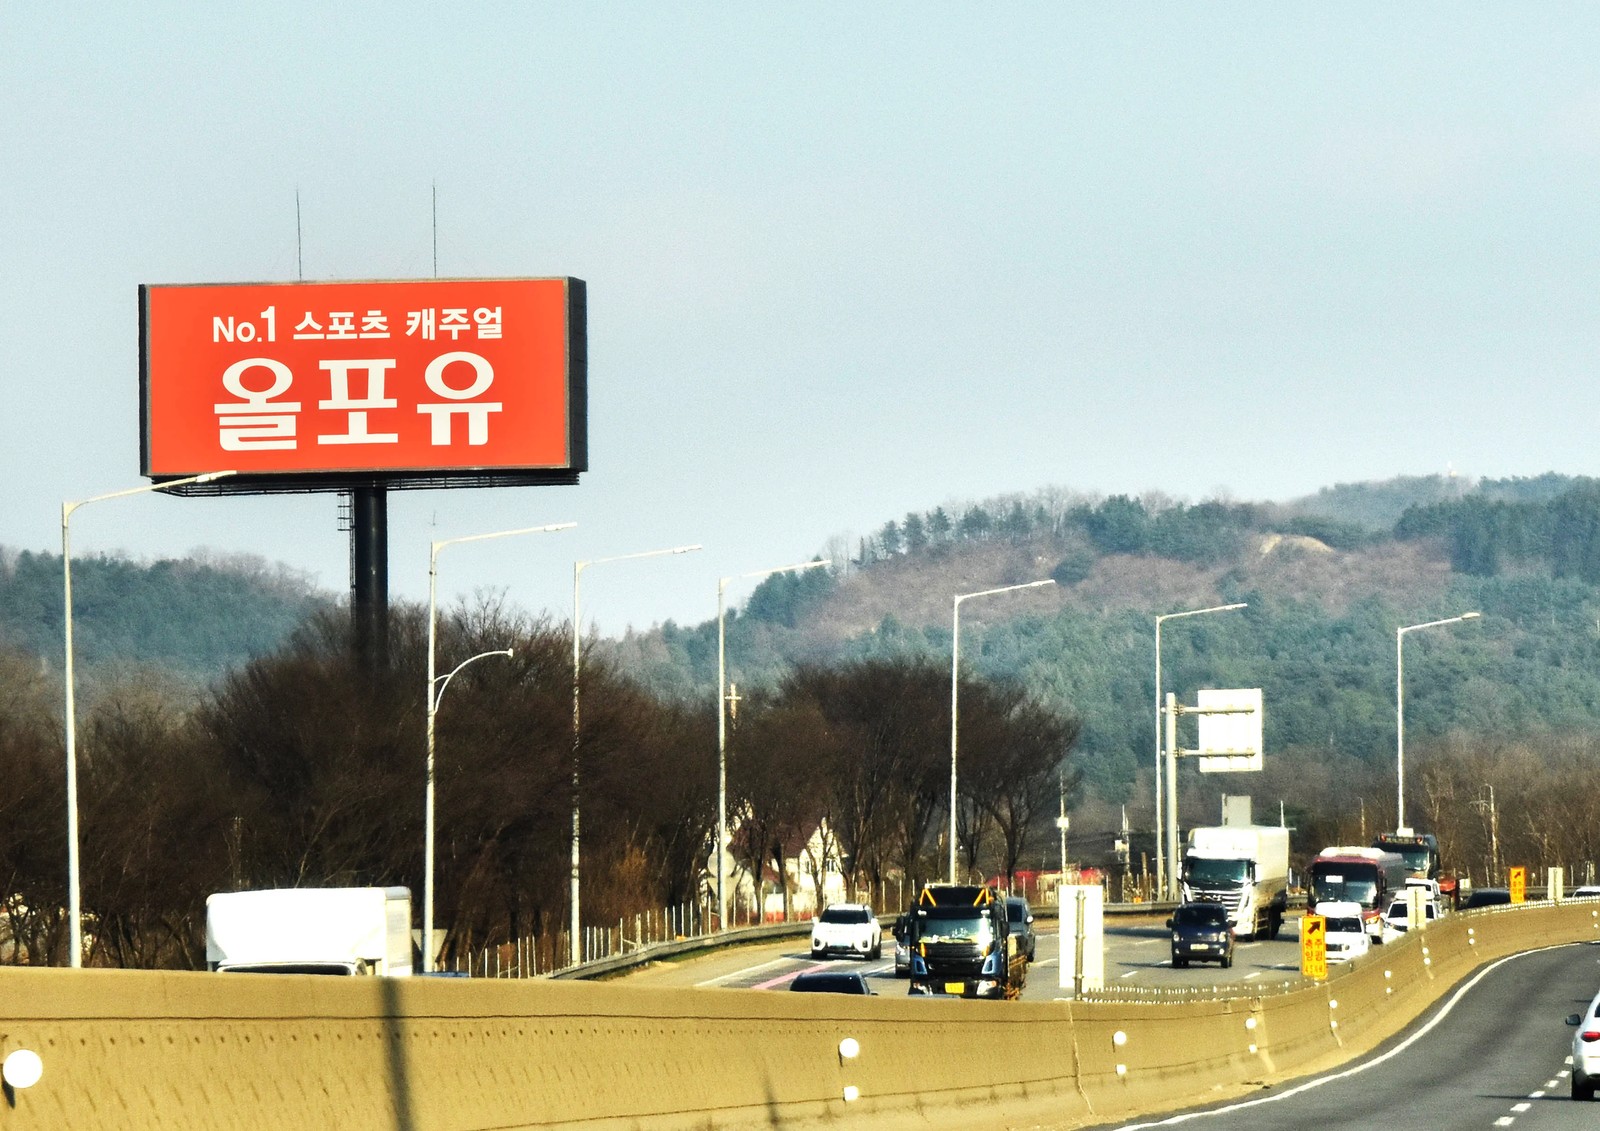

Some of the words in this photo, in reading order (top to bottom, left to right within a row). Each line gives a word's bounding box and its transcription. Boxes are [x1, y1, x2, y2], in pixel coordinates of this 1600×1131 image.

[213, 306, 276, 342] No.1
[293, 310, 391, 340] 스포츠
[406, 307, 503, 340] 캐주얼
[214, 351, 503, 452] 올포유
